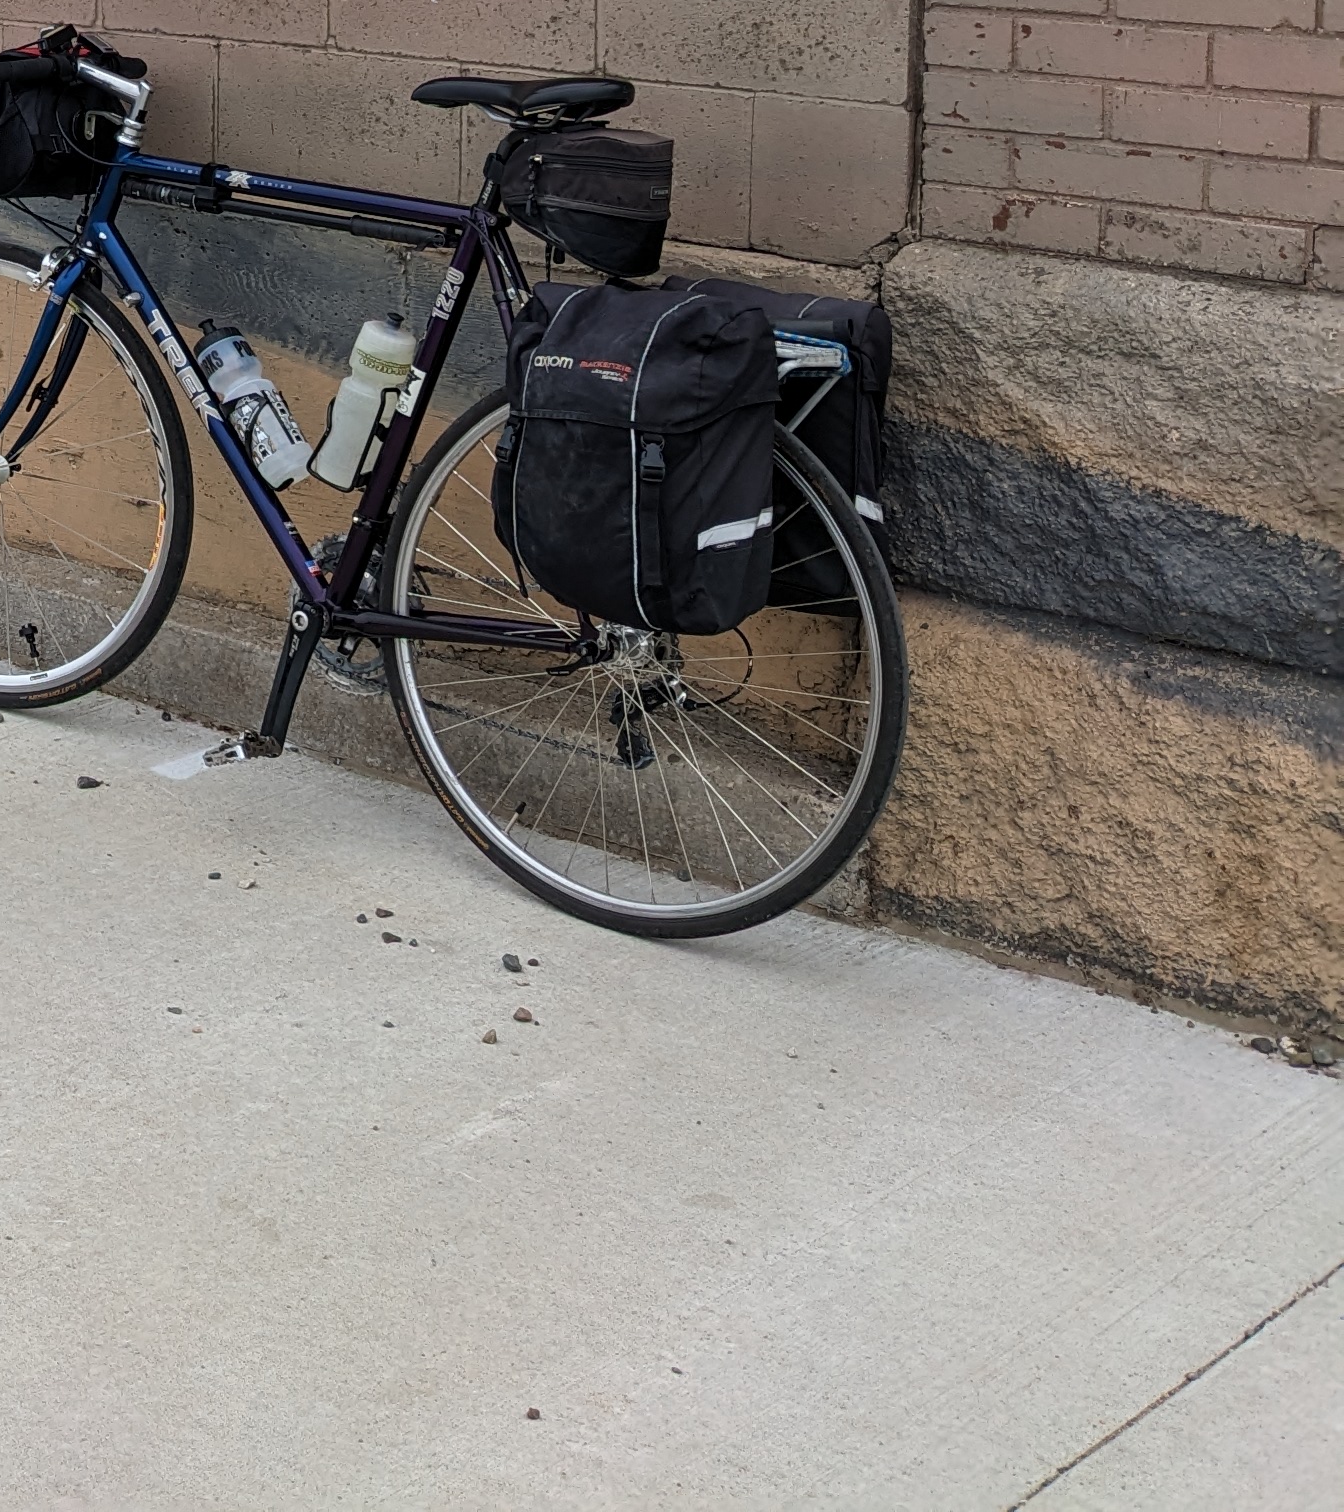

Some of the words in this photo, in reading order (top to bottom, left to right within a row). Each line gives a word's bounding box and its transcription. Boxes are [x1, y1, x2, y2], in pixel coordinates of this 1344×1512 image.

[431, 266, 465, 321] 1220
[147, 309, 225, 432] TREK
[533, 355, 574, 374] axiom
